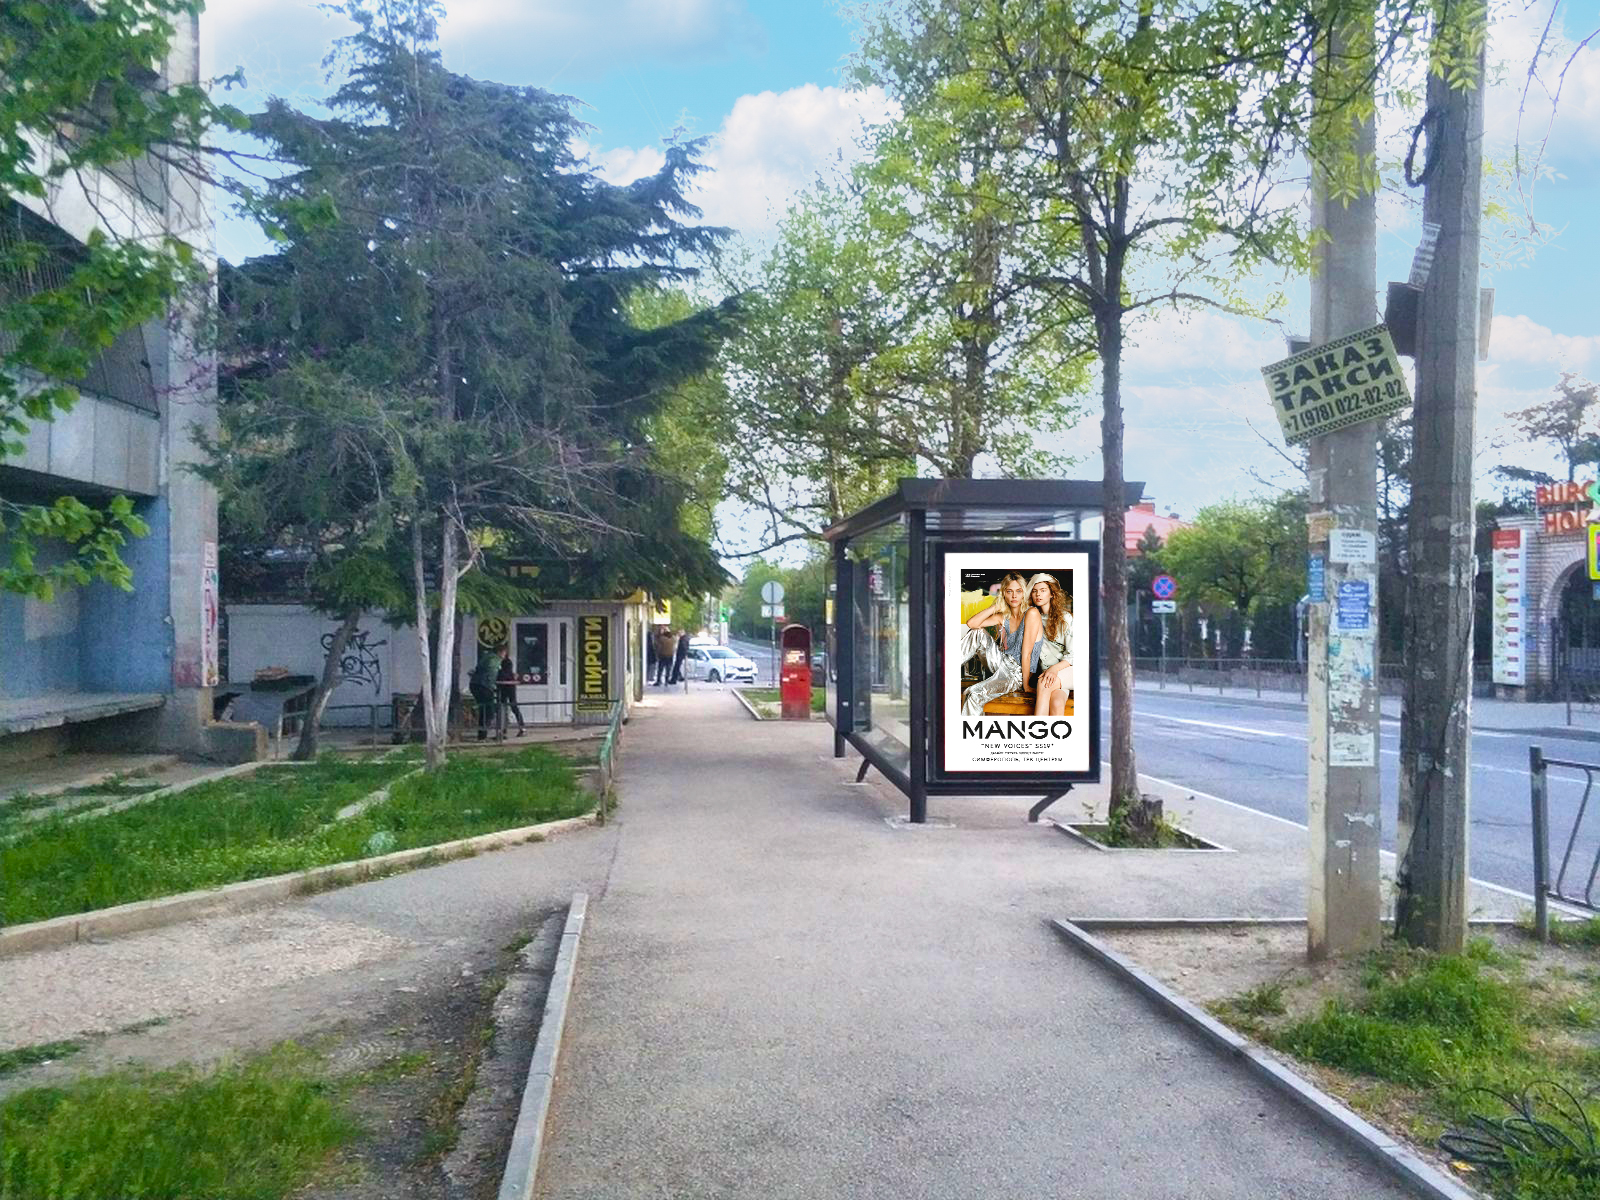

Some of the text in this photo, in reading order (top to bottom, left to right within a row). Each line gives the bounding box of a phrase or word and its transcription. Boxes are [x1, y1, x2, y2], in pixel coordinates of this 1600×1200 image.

[1271, 337, 1384, 392] ЗАКАЗ
[1275, 357, 1394, 411] ТАКСИ
[1284, 379, 1404, 431] +7 (978) 022-02-02
[584, 616, 602, 694] ПИРОГИ
[962, 720, 1073, 740] MANGO
